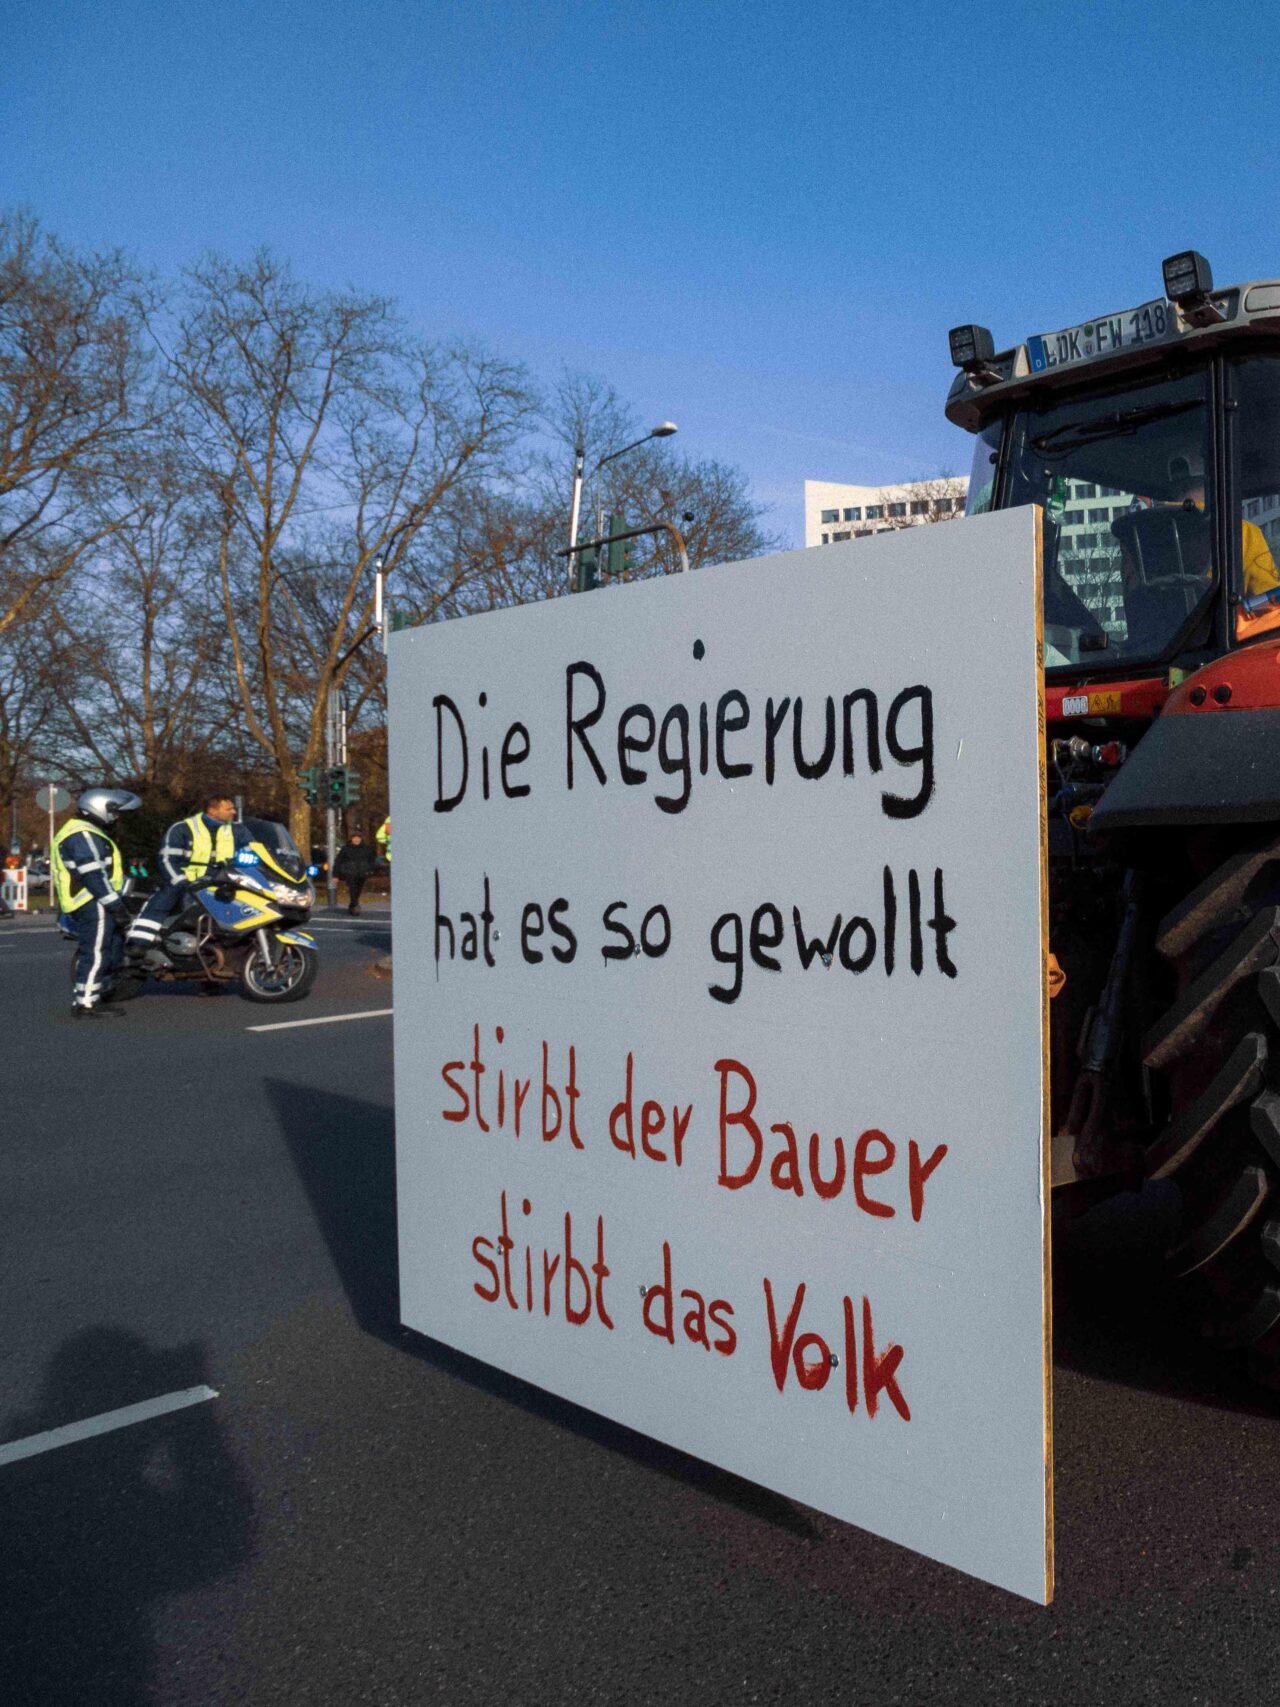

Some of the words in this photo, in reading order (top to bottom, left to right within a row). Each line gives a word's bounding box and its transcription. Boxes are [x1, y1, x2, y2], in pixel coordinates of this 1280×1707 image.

[1043, 330, 1082, 367] LDK
[1095, 318, 1123, 351] FW
[1130, 305, 1166, 344] 118
[433, 692, 531, 813] Die
[566, 640, 936, 820] Regierung
[435, 868, 496, 979] hat
[521, 898, 578, 965] es
[602, 901, 671, 967] so
[708, 865, 958, 1004] gewollt
[441, 1024, 585, 1150] stirbt
[609, 1052, 693, 1167] der
[714, 1058, 949, 1222] Bauer
[472, 1190, 614, 1330] stirbt
[641, 1241, 737, 1357] das
[763, 1278, 912, 1423] Volk
